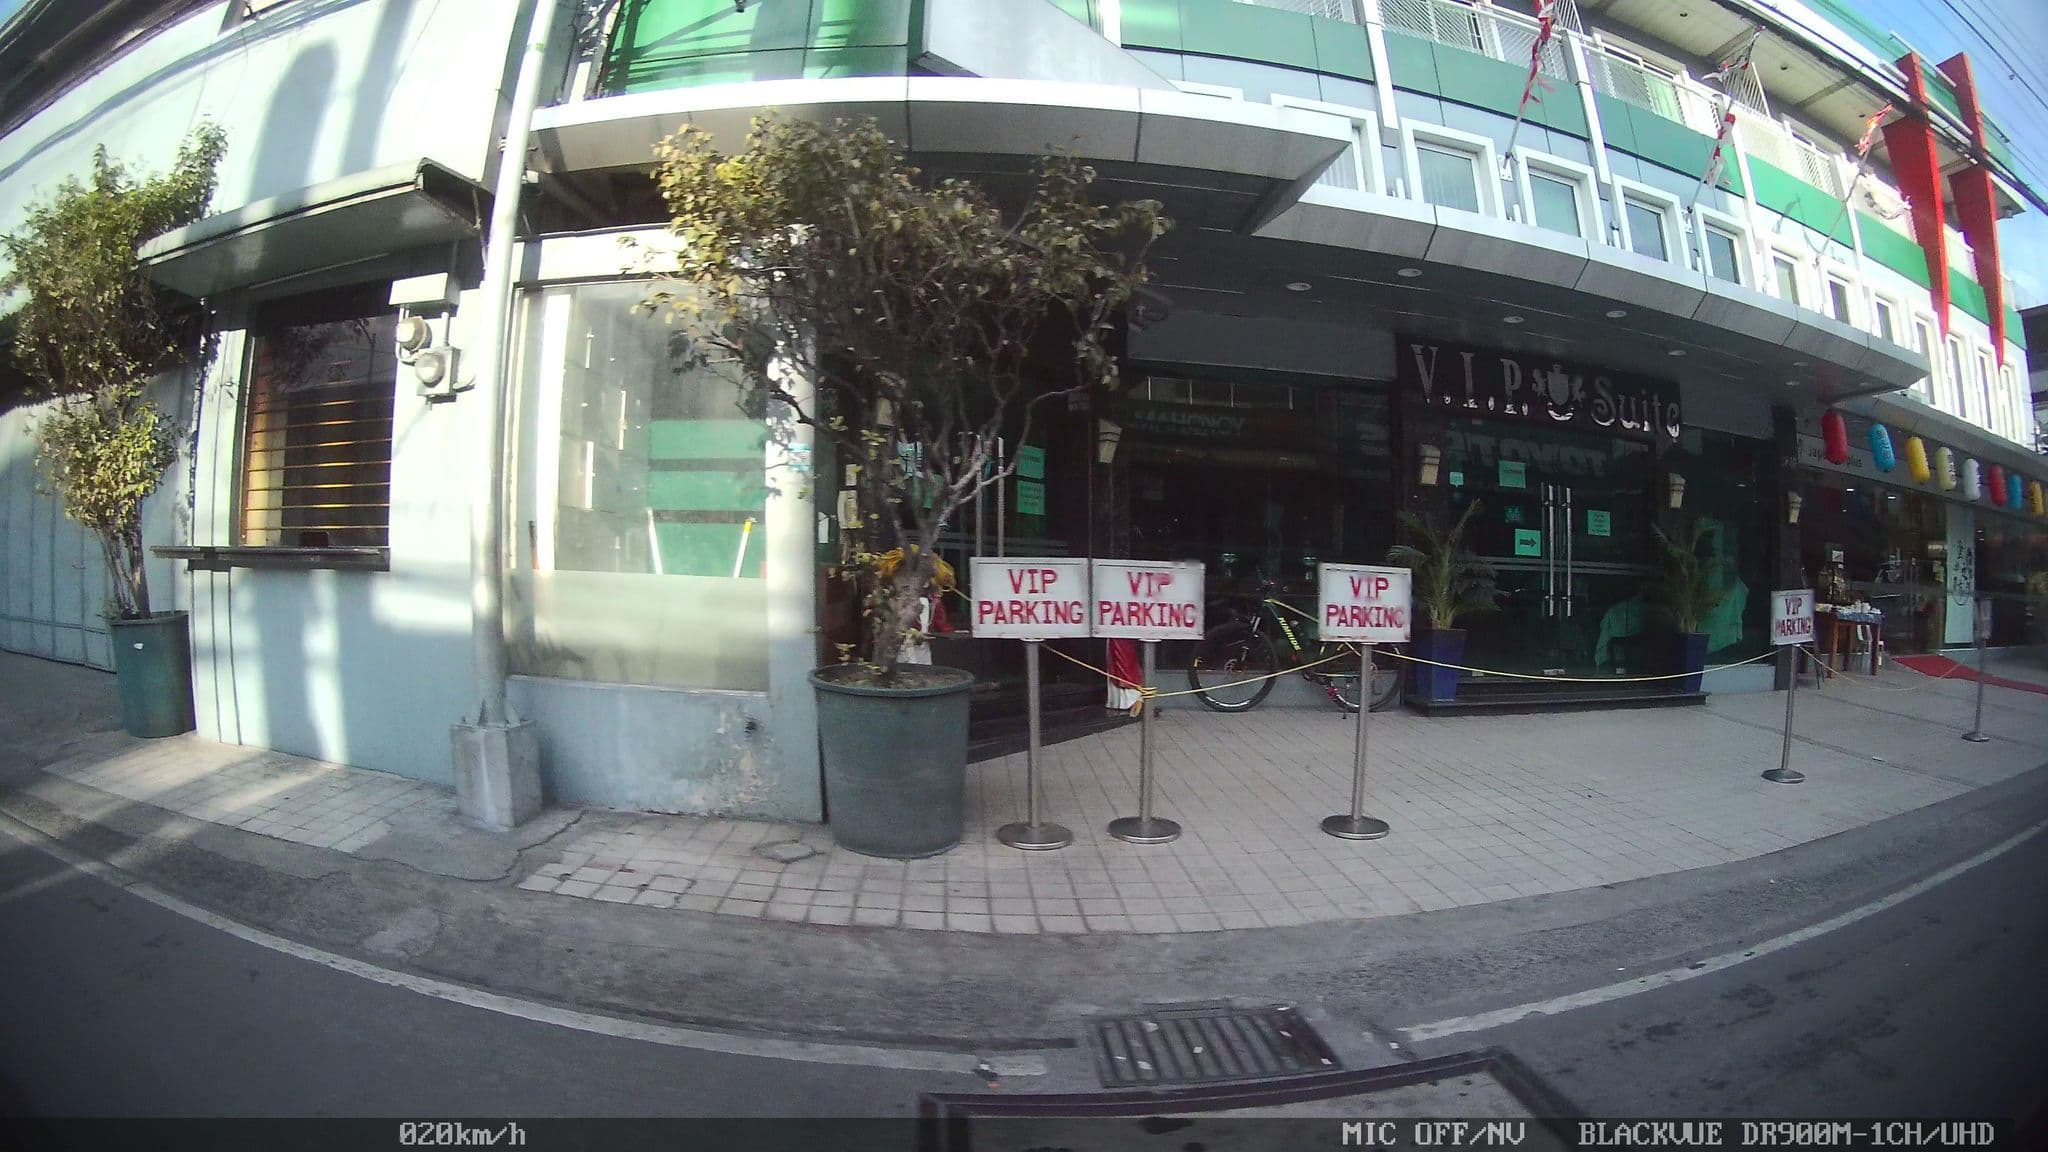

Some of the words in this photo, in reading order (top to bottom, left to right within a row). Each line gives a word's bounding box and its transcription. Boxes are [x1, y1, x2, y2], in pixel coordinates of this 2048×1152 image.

[1590, 375, 1681, 439] Suite
[1008, 568, 1058, 595] VIP
[1126, 571, 1174, 599] VIP
[1349, 575, 1389, 601] VIP
[978, 599, 1084, 626] PARKING
[1785, 597, 1803, 616] VIP
[1776, 617, 1812, 636] PARKING
